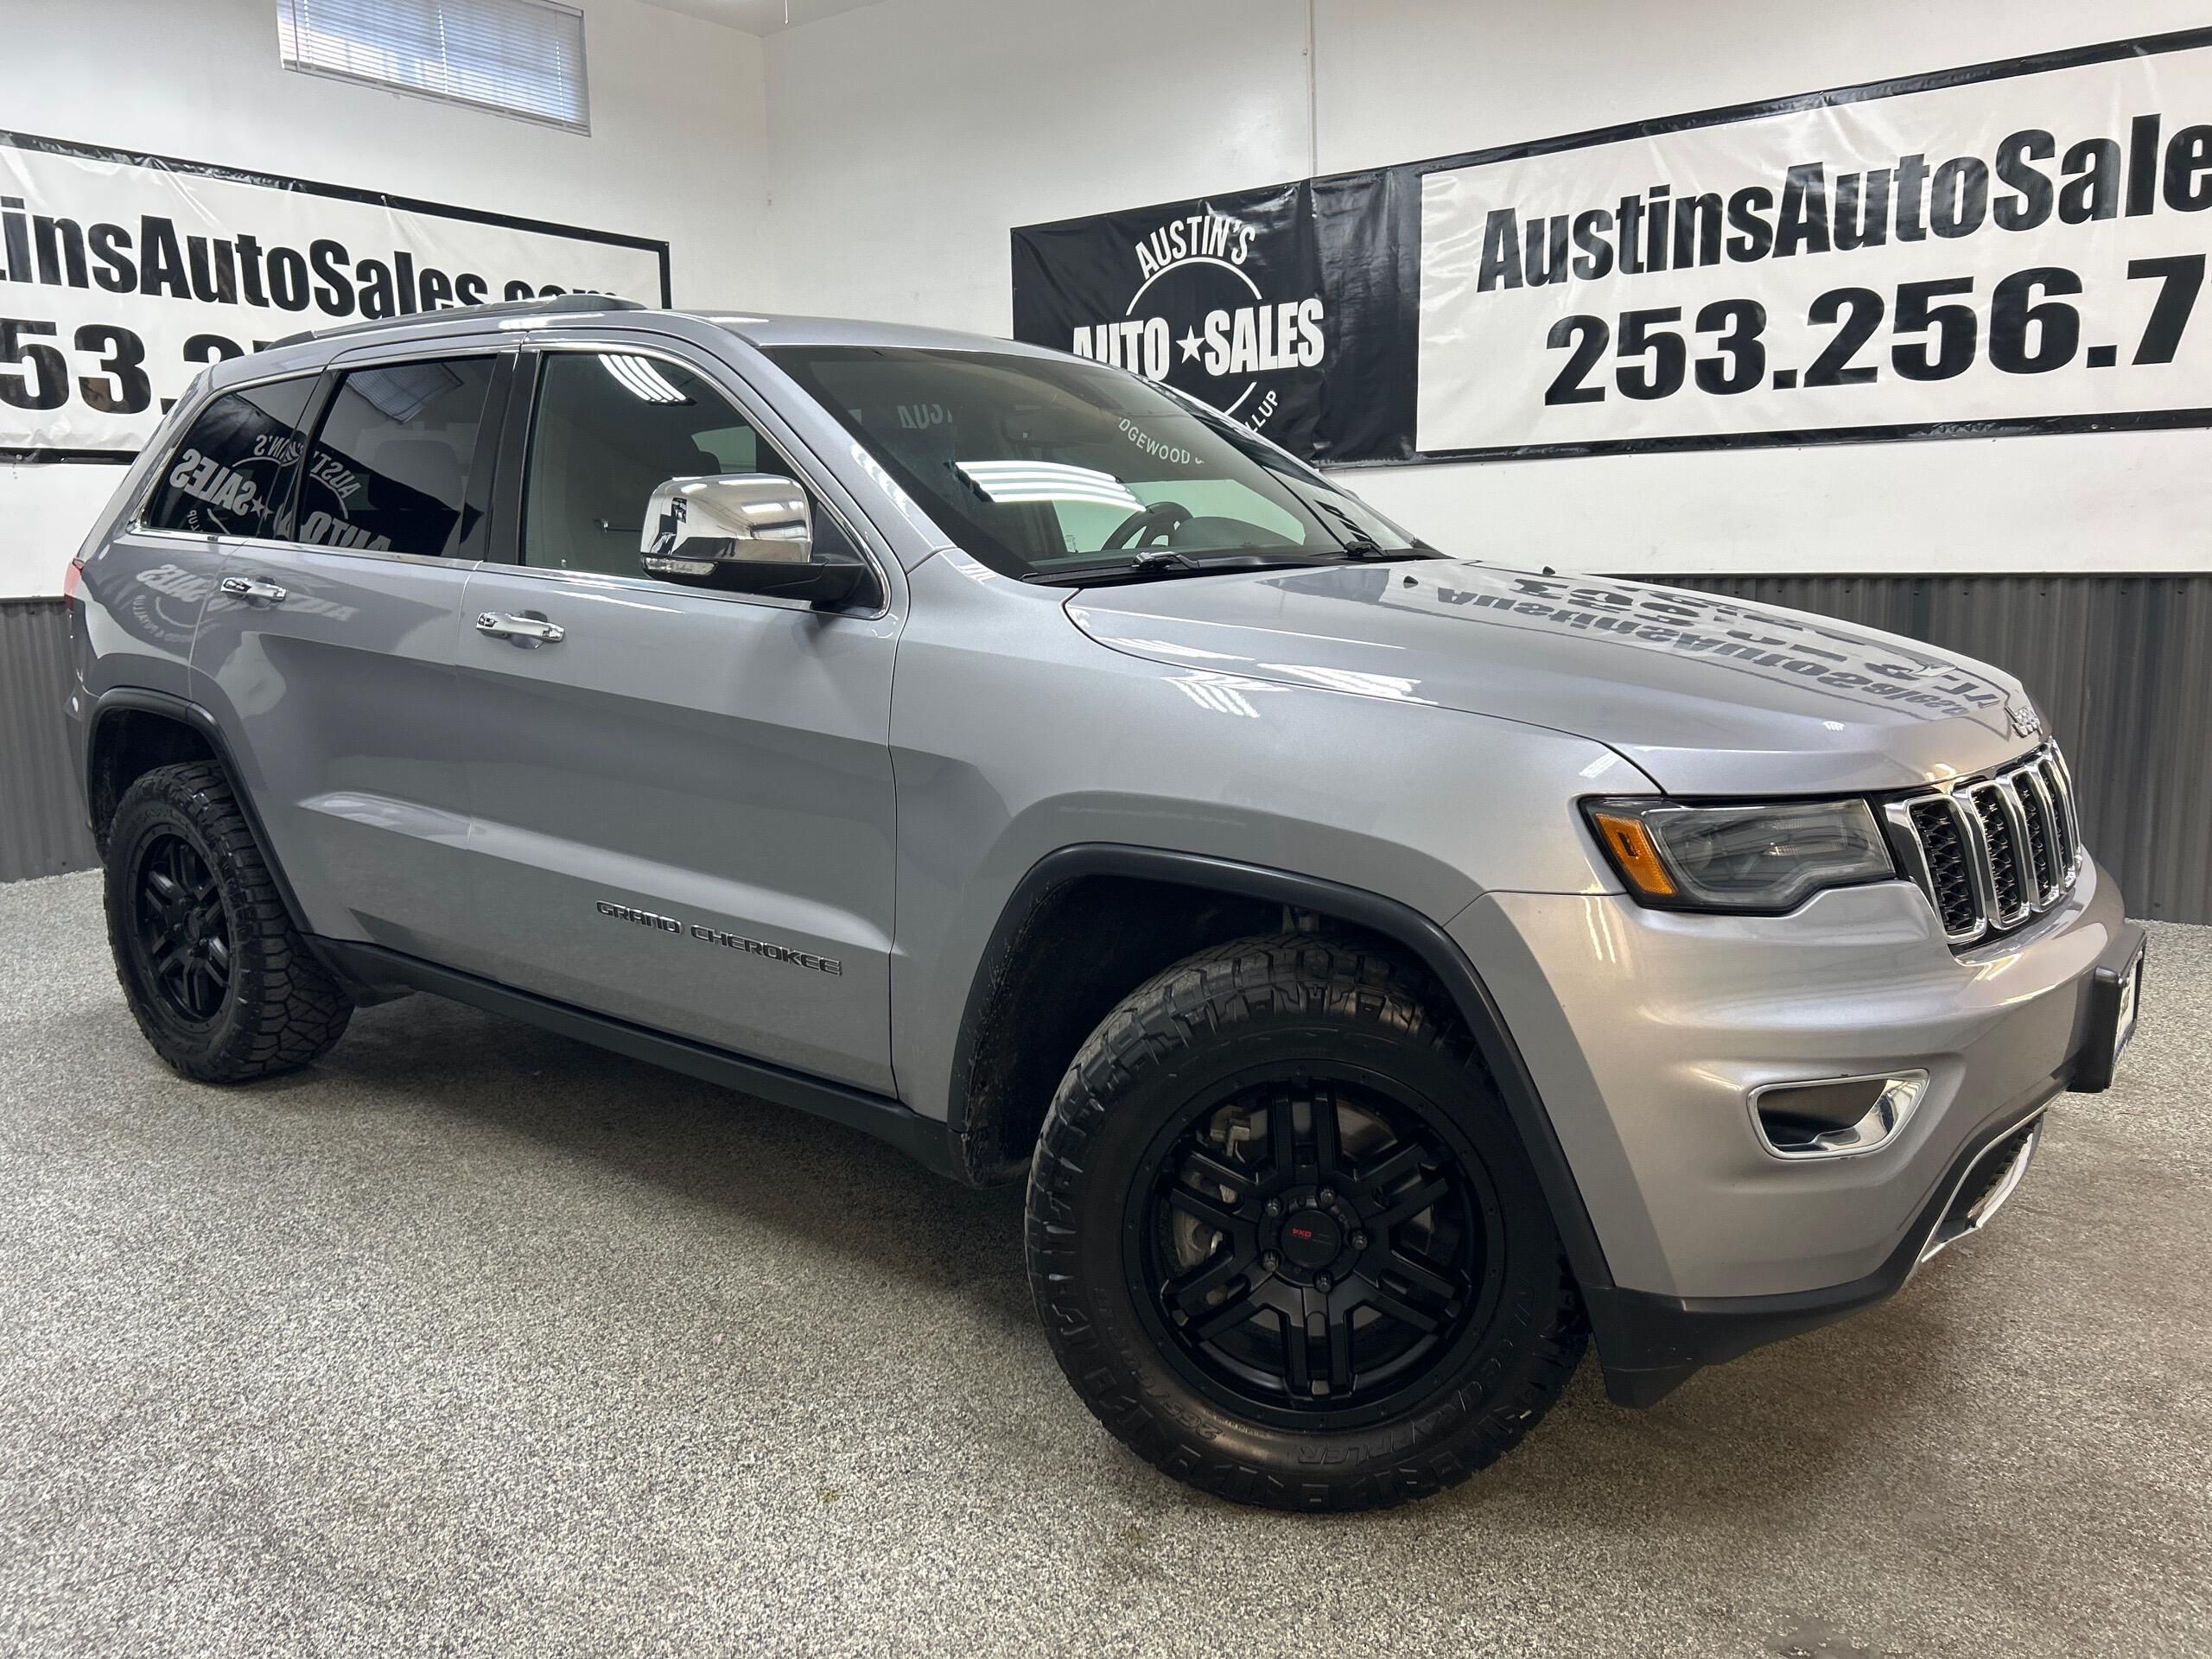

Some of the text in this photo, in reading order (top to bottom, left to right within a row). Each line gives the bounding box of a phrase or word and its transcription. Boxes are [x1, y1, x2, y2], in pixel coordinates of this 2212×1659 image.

[1477, 113, 2212, 292] AustinsAutoSale
[1134, 214, 1255, 280] AUSTIN'S
[1072, 297, 1325, 381] AUTO SALES
[1118, 416, 1191, 465] DGEWOOD
[595, 899, 843, 976] GRAND CHEROKEE
